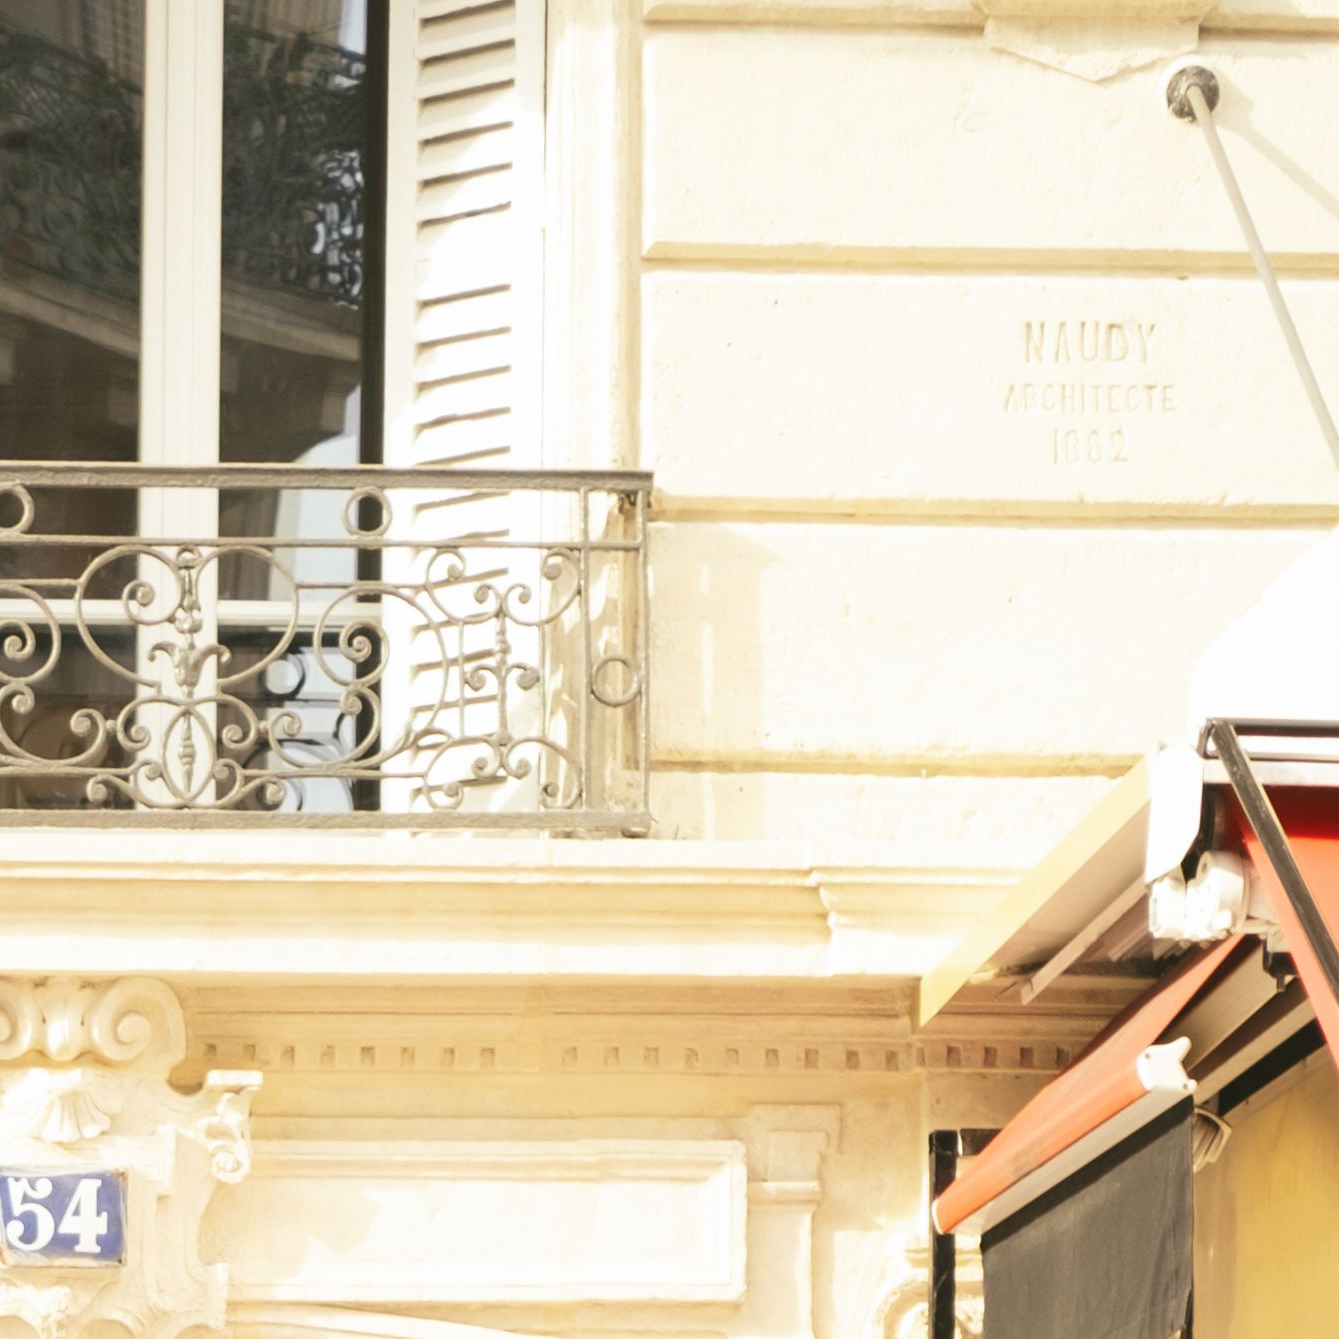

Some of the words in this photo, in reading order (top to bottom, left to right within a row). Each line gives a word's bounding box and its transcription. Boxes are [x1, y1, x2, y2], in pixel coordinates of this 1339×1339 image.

[1023, 319, 1157, 364] NAUDY
[1003, 382, 1178, 414] ARCHITECTE
[1052, 428, 1130, 464] 1882
[5, 1176, 109, 1254] 54
